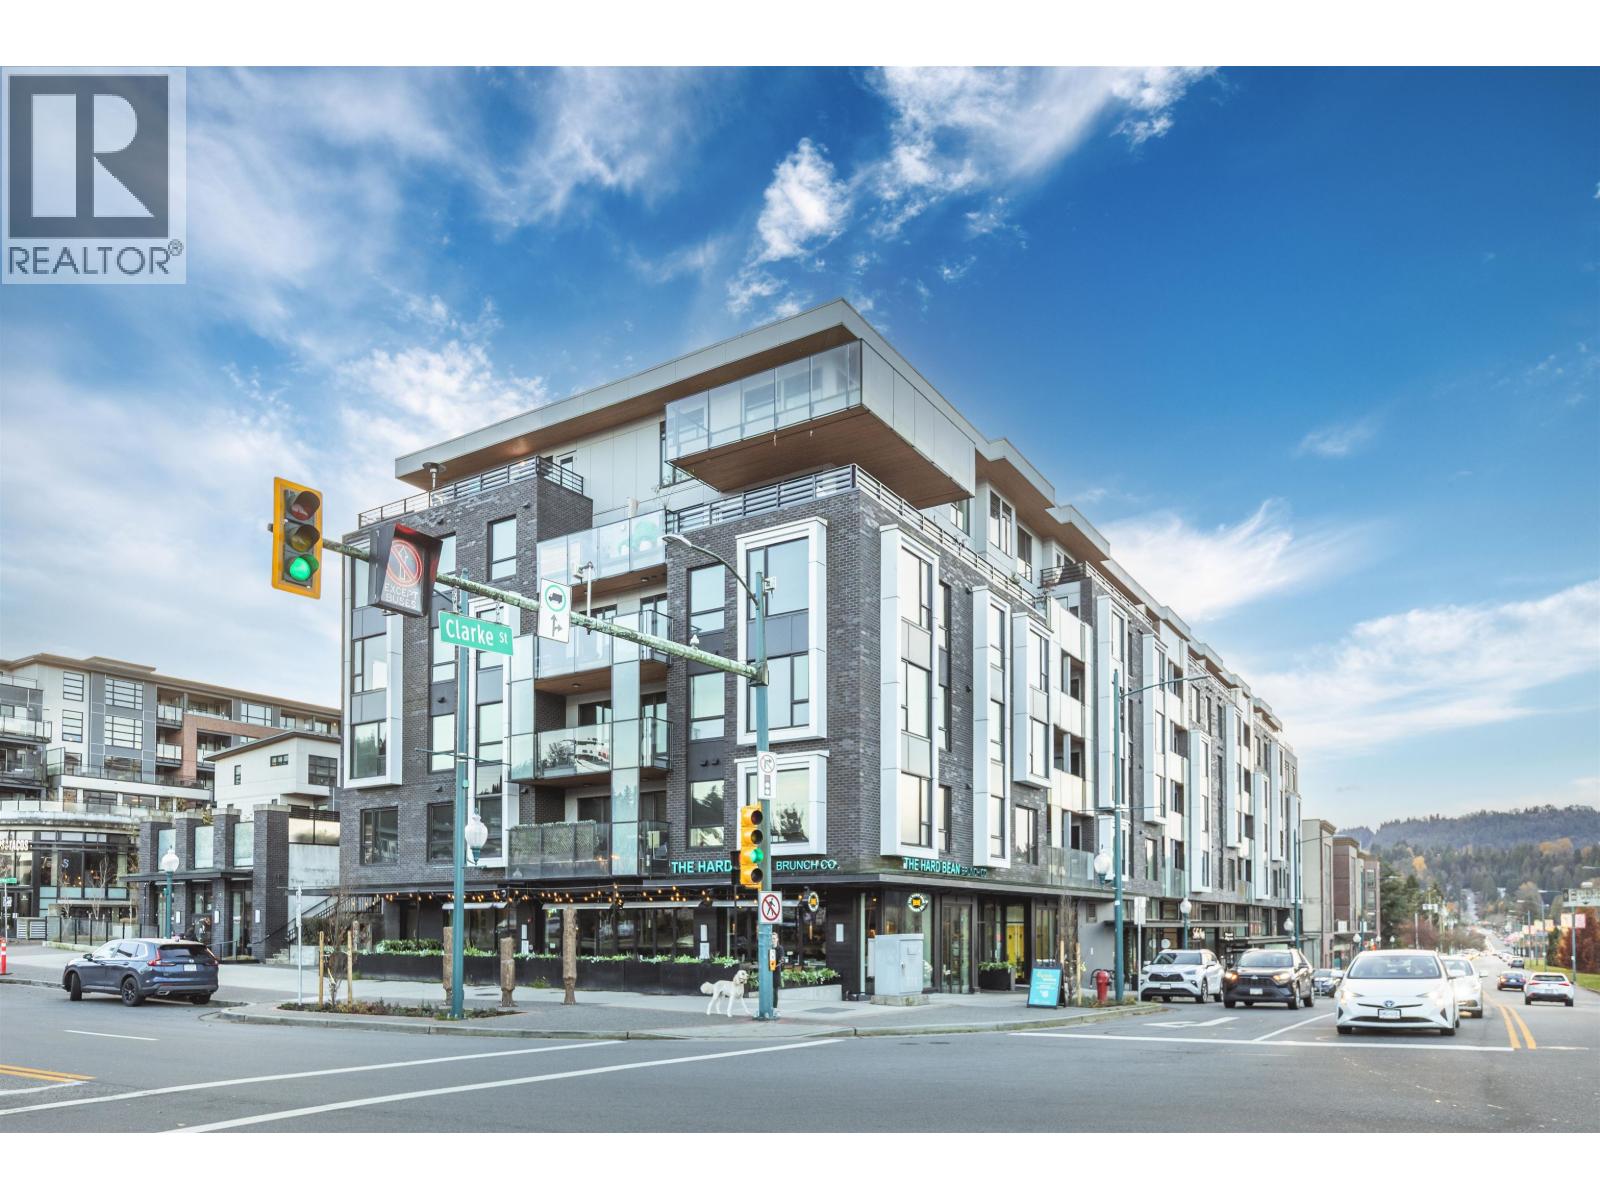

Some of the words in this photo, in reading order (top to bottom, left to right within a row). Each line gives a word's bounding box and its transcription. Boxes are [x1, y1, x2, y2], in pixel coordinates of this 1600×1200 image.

[384, 583, 418, 600] EXCEPT
[385, 593, 417, 609] BUSES
[445, 619, 494, 646] Clarke
[499, 631, 508, 644] St
[671, 861, 697, 874] THE
[698, 860, 733, 873] HARD
[776, 860, 818, 871] BRUNCH
[903, 857, 920, 871] THE
[920, 859, 941, 873] HARD
[941, 861, 961, 875] BEAN
